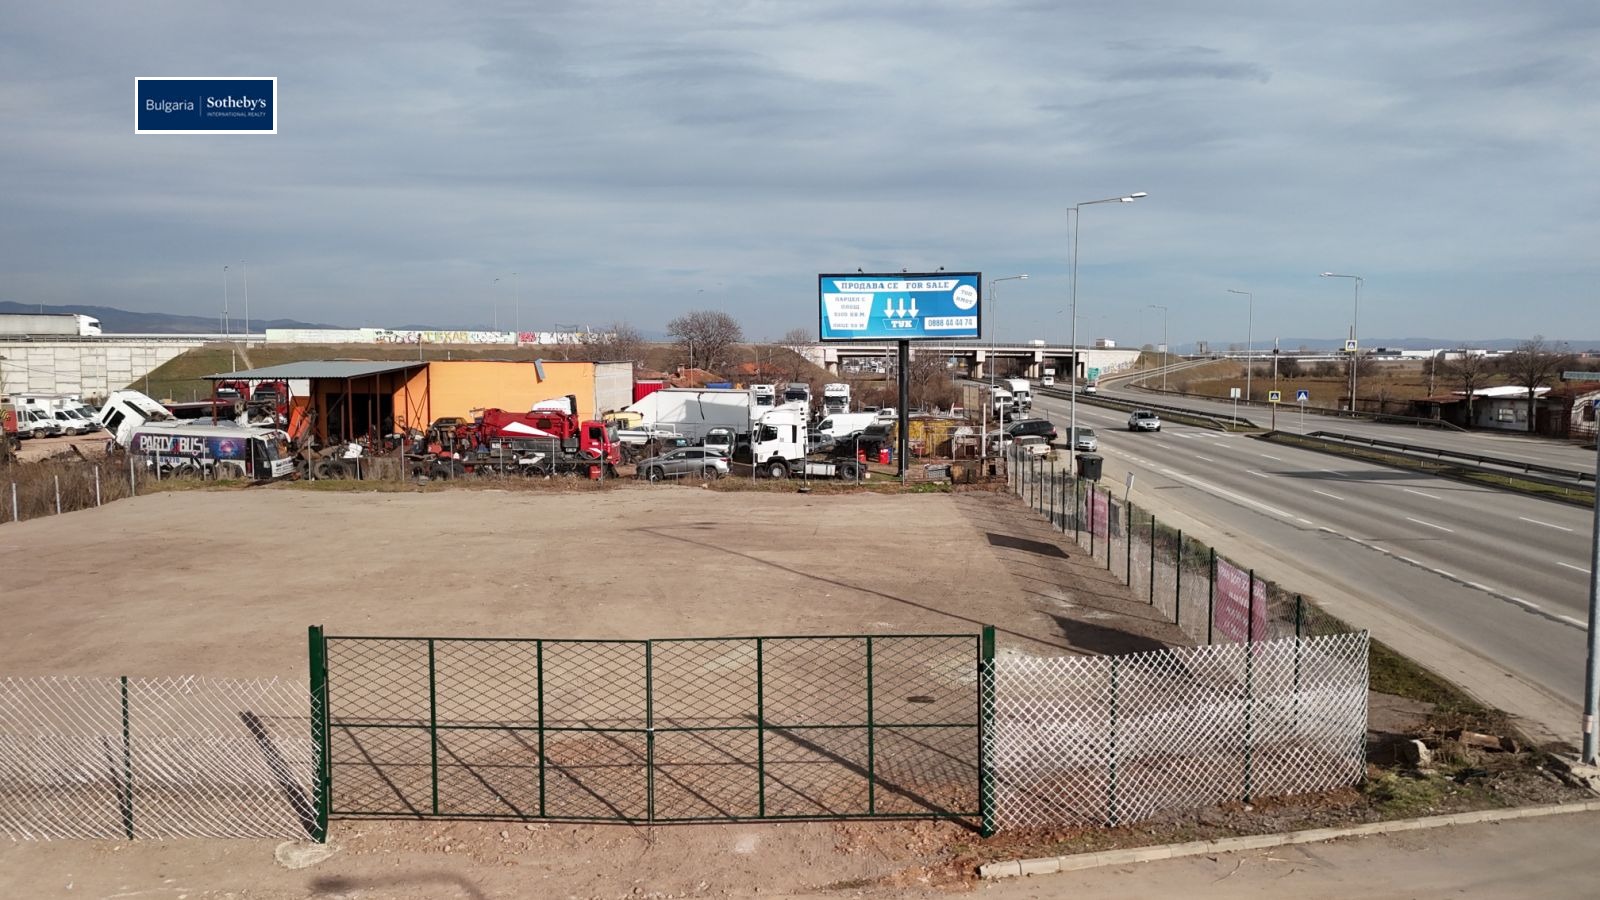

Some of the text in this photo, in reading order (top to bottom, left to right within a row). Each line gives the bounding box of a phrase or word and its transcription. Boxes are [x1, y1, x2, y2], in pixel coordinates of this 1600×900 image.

[841, 282, 884, 290] ПРОДАВА
[926, 281, 950, 289] SALE
[140, 435, 204, 452] PARTY BUS
